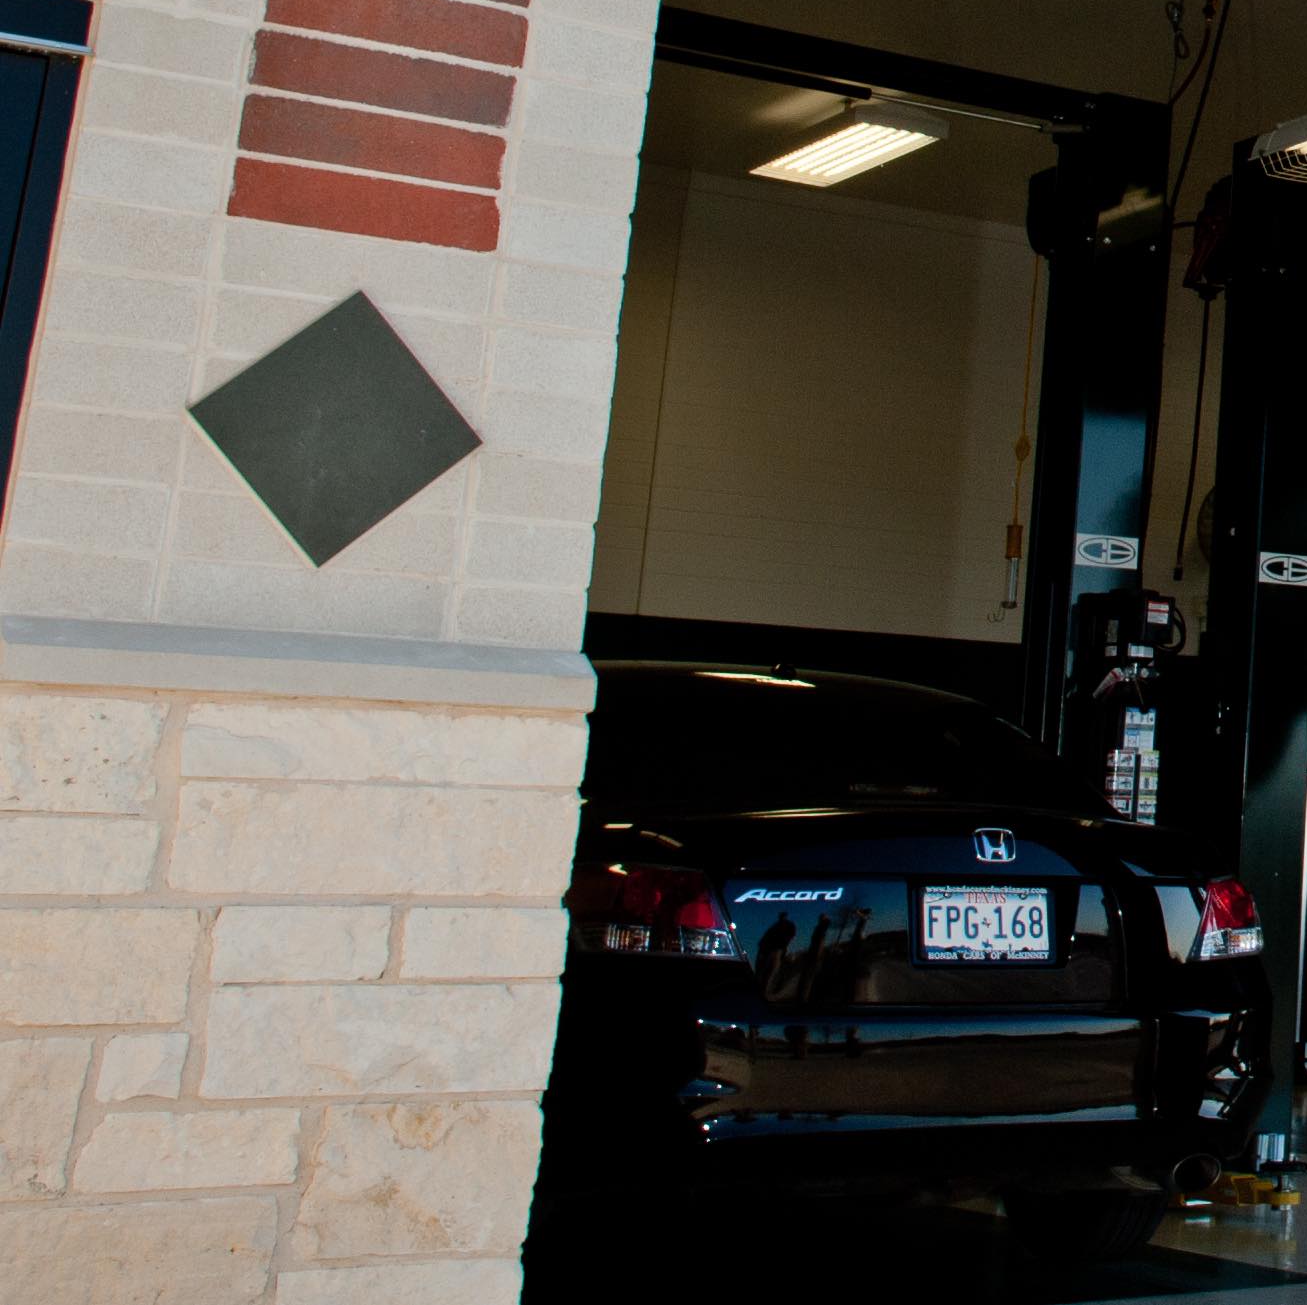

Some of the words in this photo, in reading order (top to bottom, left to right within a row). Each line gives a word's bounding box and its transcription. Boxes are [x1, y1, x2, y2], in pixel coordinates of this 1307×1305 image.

[734, 887, 844, 903] Accord
[966, 892, 1007, 904] TEXAS
[928, 905, 979, 939] FPG
[993, 905, 1044, 939] 168
[927, 951, 958, 960] HONDA
